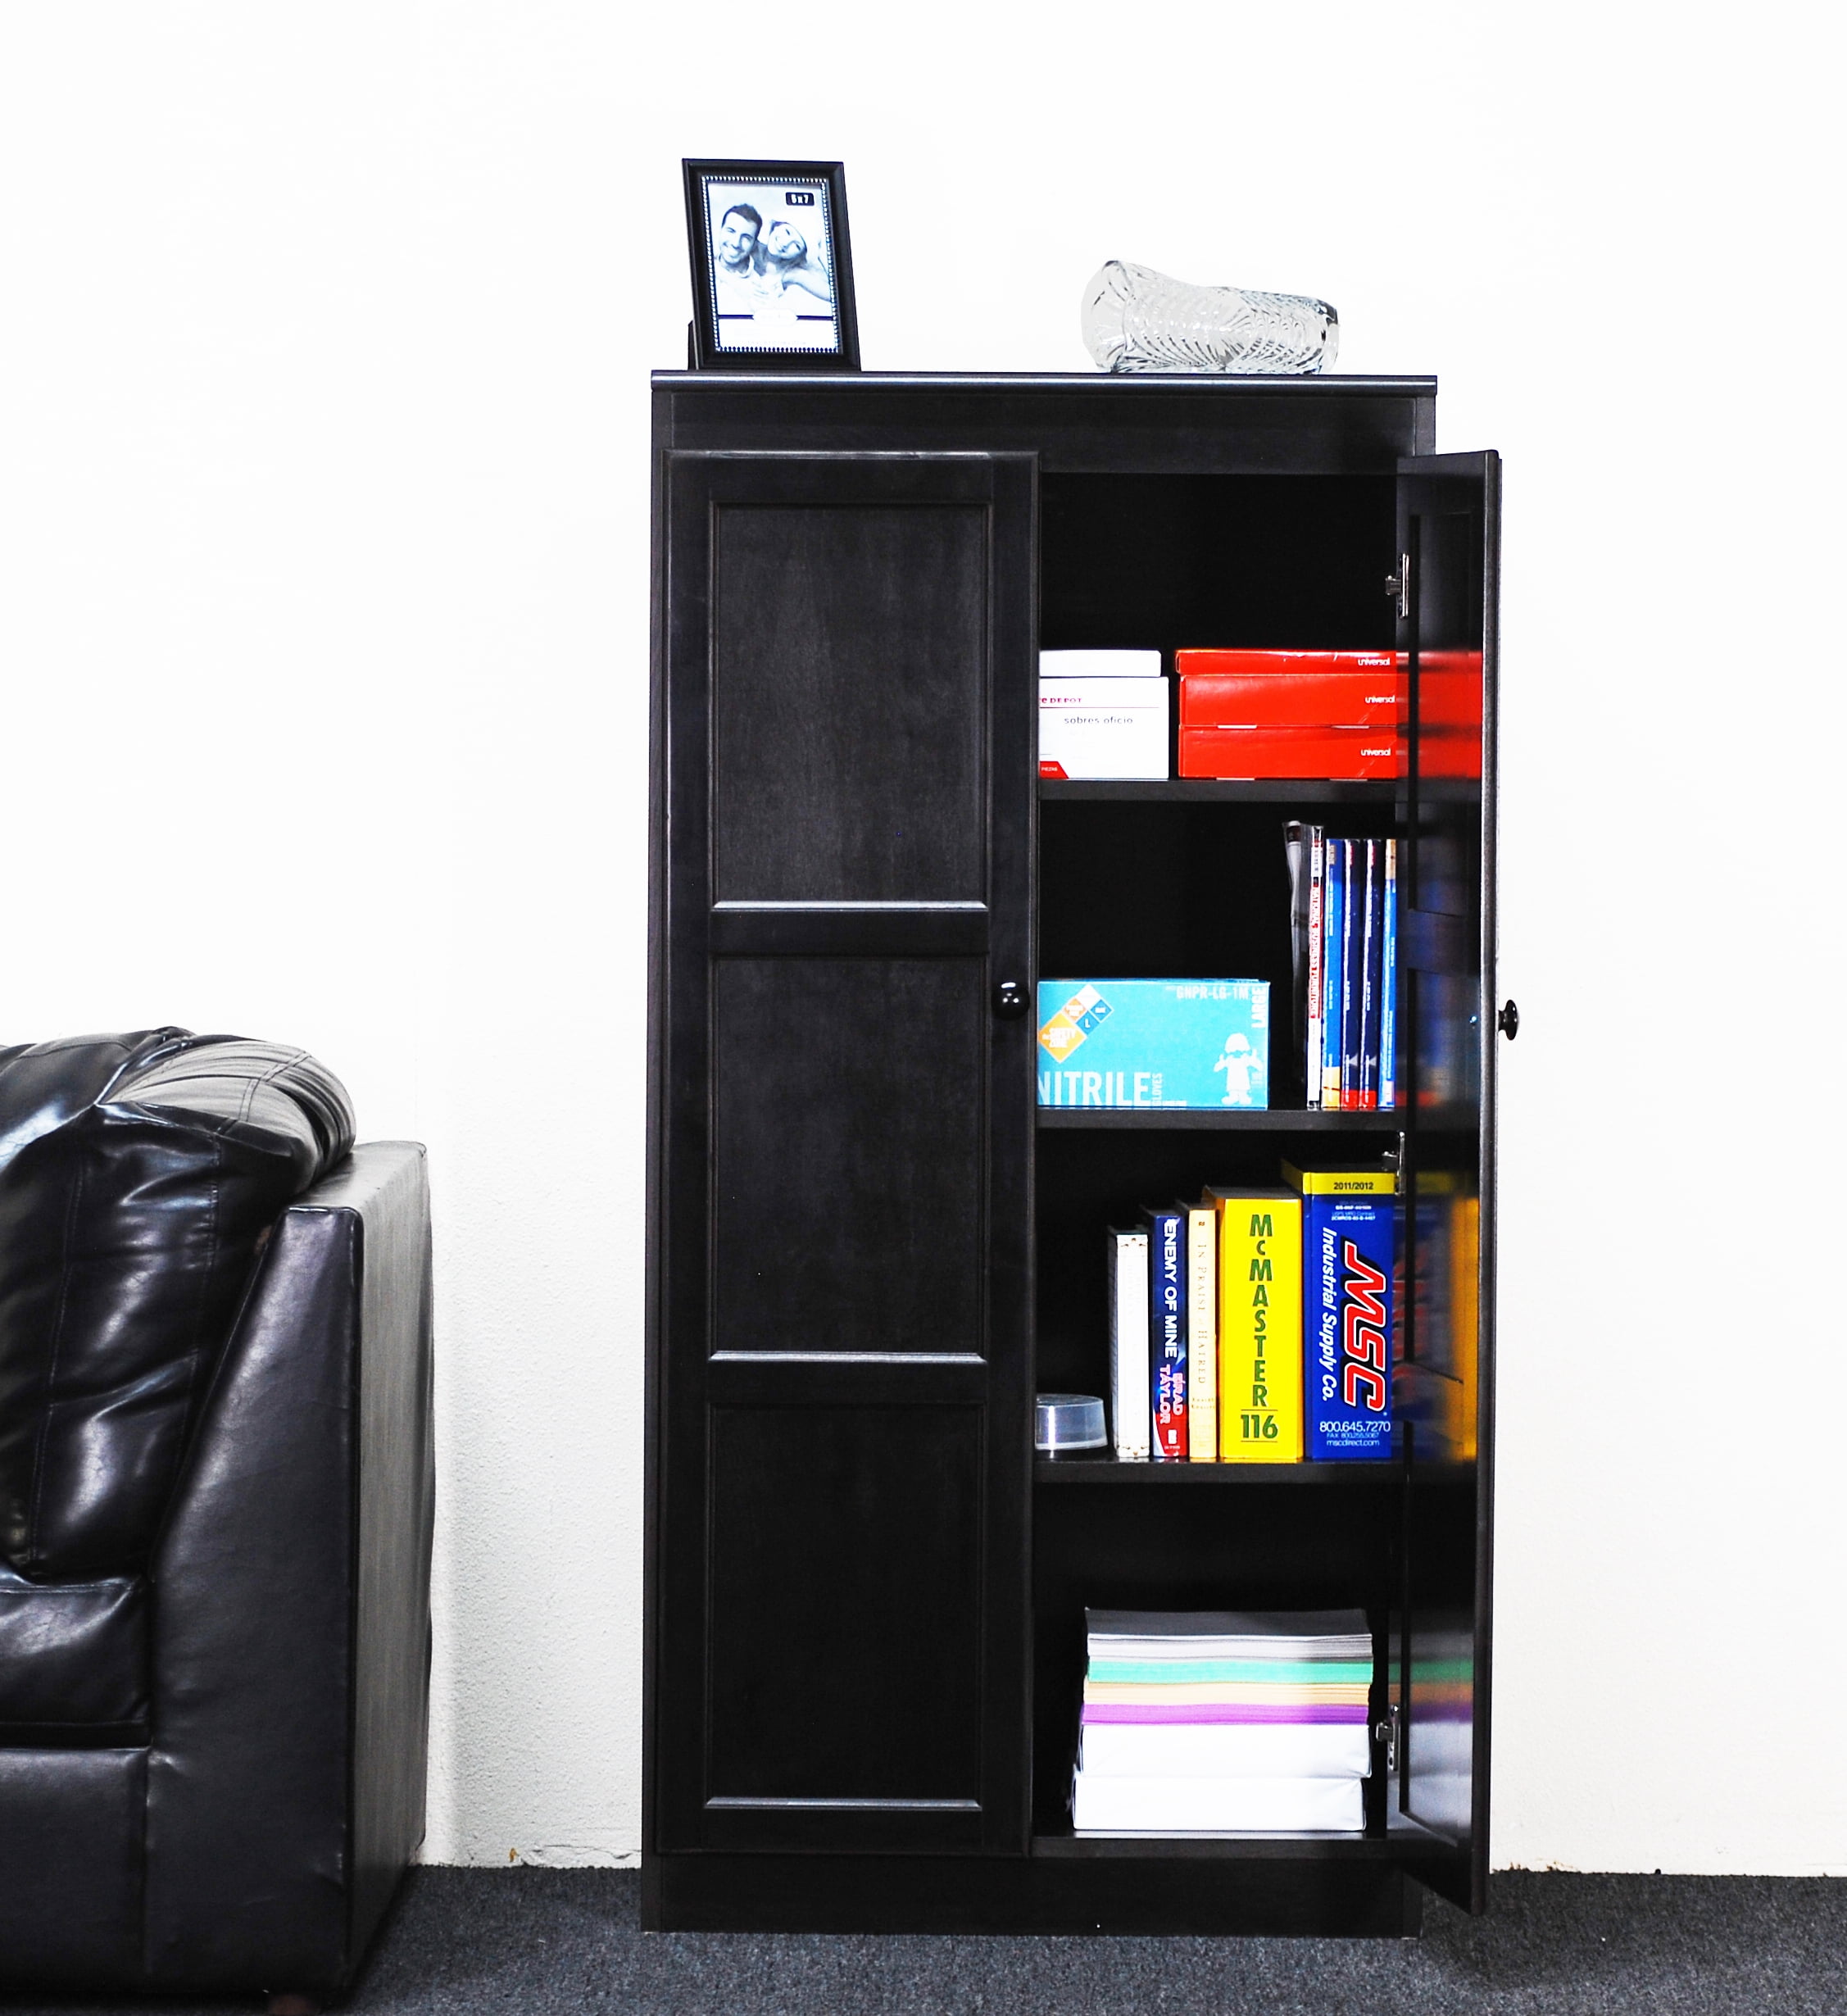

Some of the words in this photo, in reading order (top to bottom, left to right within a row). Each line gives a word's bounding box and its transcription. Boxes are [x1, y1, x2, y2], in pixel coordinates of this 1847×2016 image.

[1358, 657, 1391, 666] universal
[1365, 695, 1395, 704] universal
[1064, 715, 1100, 724] sobres
[1103, 715, 1133, 724] oficio
[1360, 747, 1391, 756] universal
[1251, 986, 1267, 1028] LARGE
[1037, 1071, 1151, 1107] NITRILE
[1333, 1181, 1374, 1191] 2011/2012
[1164, 1219, 1178, 1283] ENEMY
[1197, 1244, 1208, 1259] IN
[1322, 1227, 1338, 1311] Industrial
[1164, 1287, 1178, 1312] OF
[1197, 1266, 1208, 1311] PRAISE
[1164, 1314, 1178, 1359] MINE
[1318, 1313, 1338, 1374] Supply
[1343, 1238, 1387, 1413] MSC
[1197, 1329, 1209, 1385] HATRED
[1159, 1364, 1172, 1424] TAYLOR
[1173, 1373, 1184, 1415] BRAD
[1322, 1376, 1338, 1401] Co.
[1241, 1414, 1279, 1439] 116
[1318, 1420, 1391, 1433] 800.645.7270
